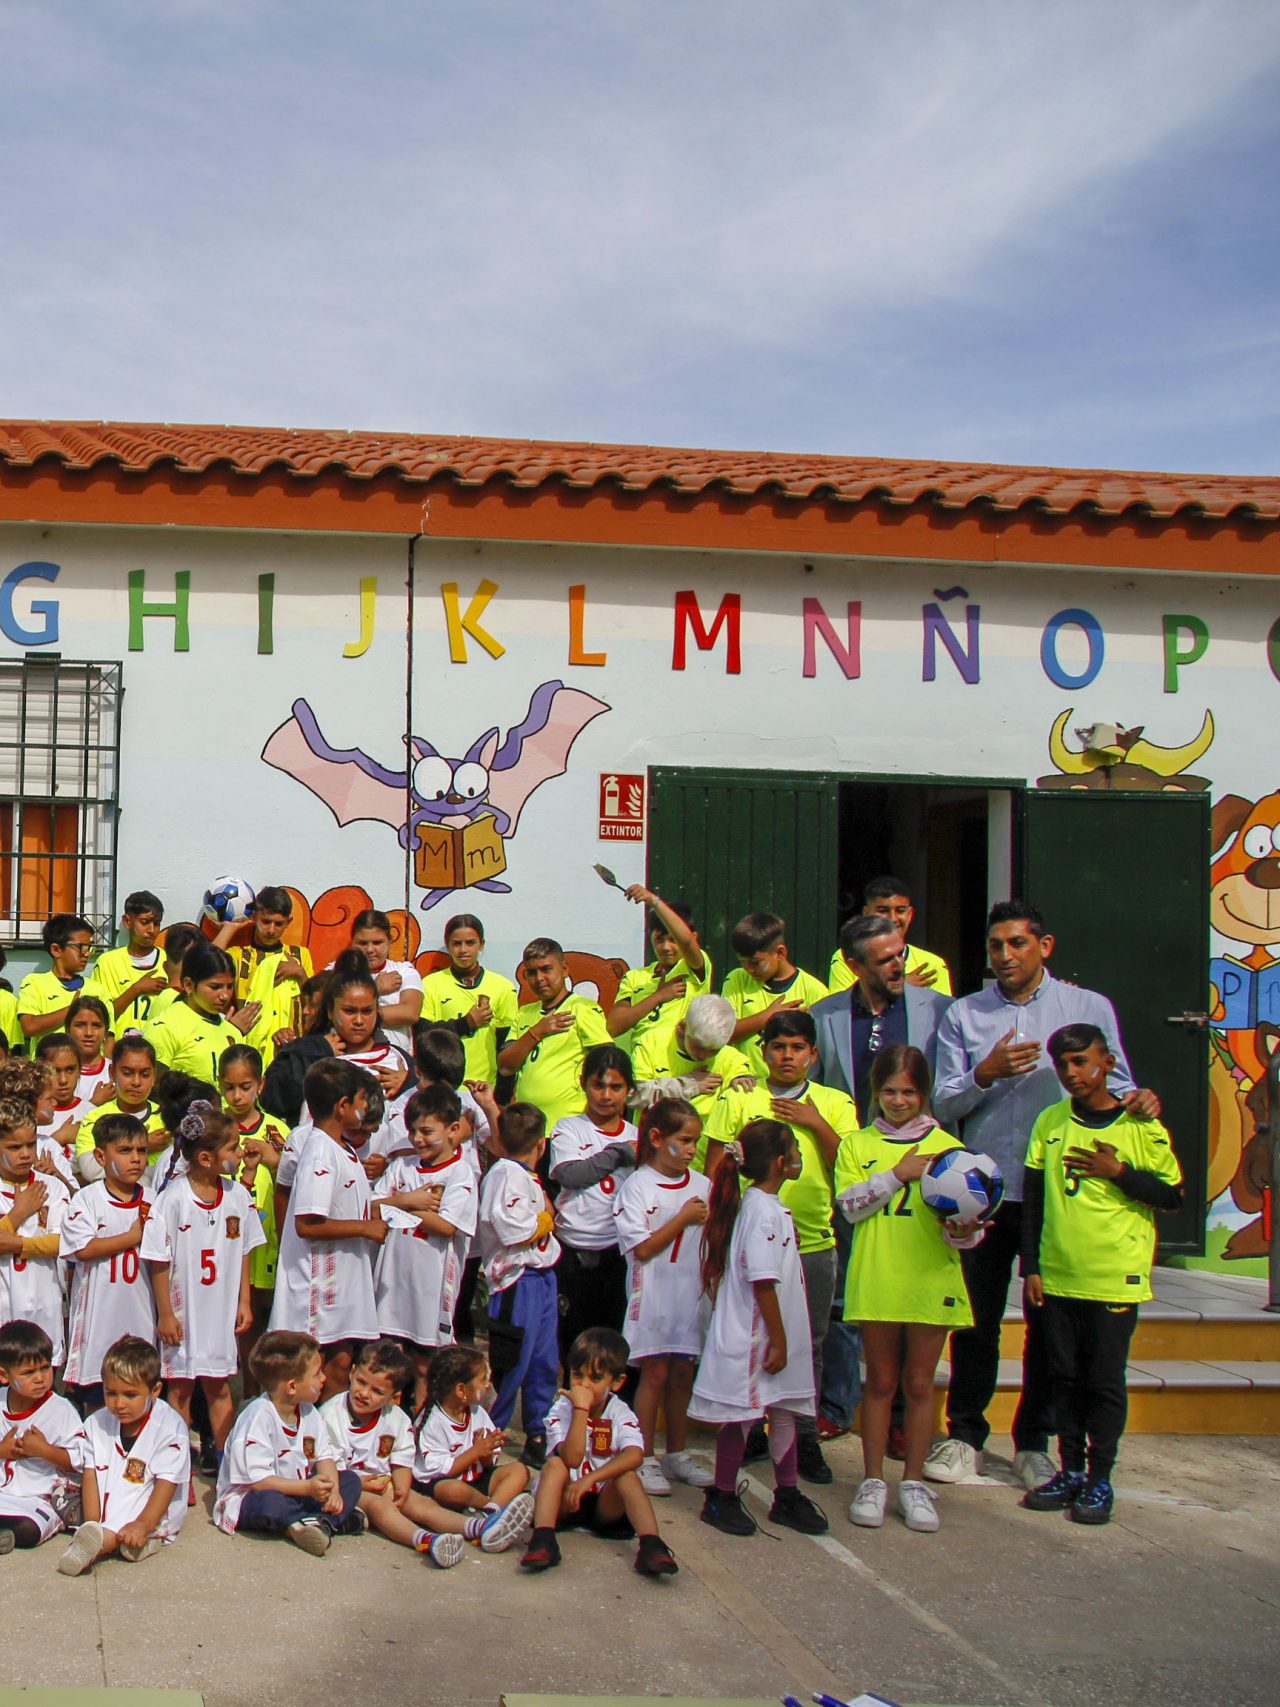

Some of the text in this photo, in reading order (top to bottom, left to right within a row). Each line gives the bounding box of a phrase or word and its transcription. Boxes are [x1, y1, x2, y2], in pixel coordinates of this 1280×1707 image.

[128, 569, 191, 652] H
[258, 572, 275, 654] I
[343, 576, 378, 658] J
[440, 577, 506, 664] K
[568, 583, 607, 667] L
[671, 589, 742, 674] M
[803, 597, 862, 680] N
[922, 585, 981, 684] Ñ
[1040, 608, 1105, 690] O
[1162, 614, 1210, 693] P
[600, 824, 642, 837] EXTINTOR
[422, 839, 501, 872] M m
[1222, 971, 1243, 1005] P
[133, 995, 151, 1021] 12
[109, 1249, 140, 1285] 10
[200, 1248, 218, 1286] 5
